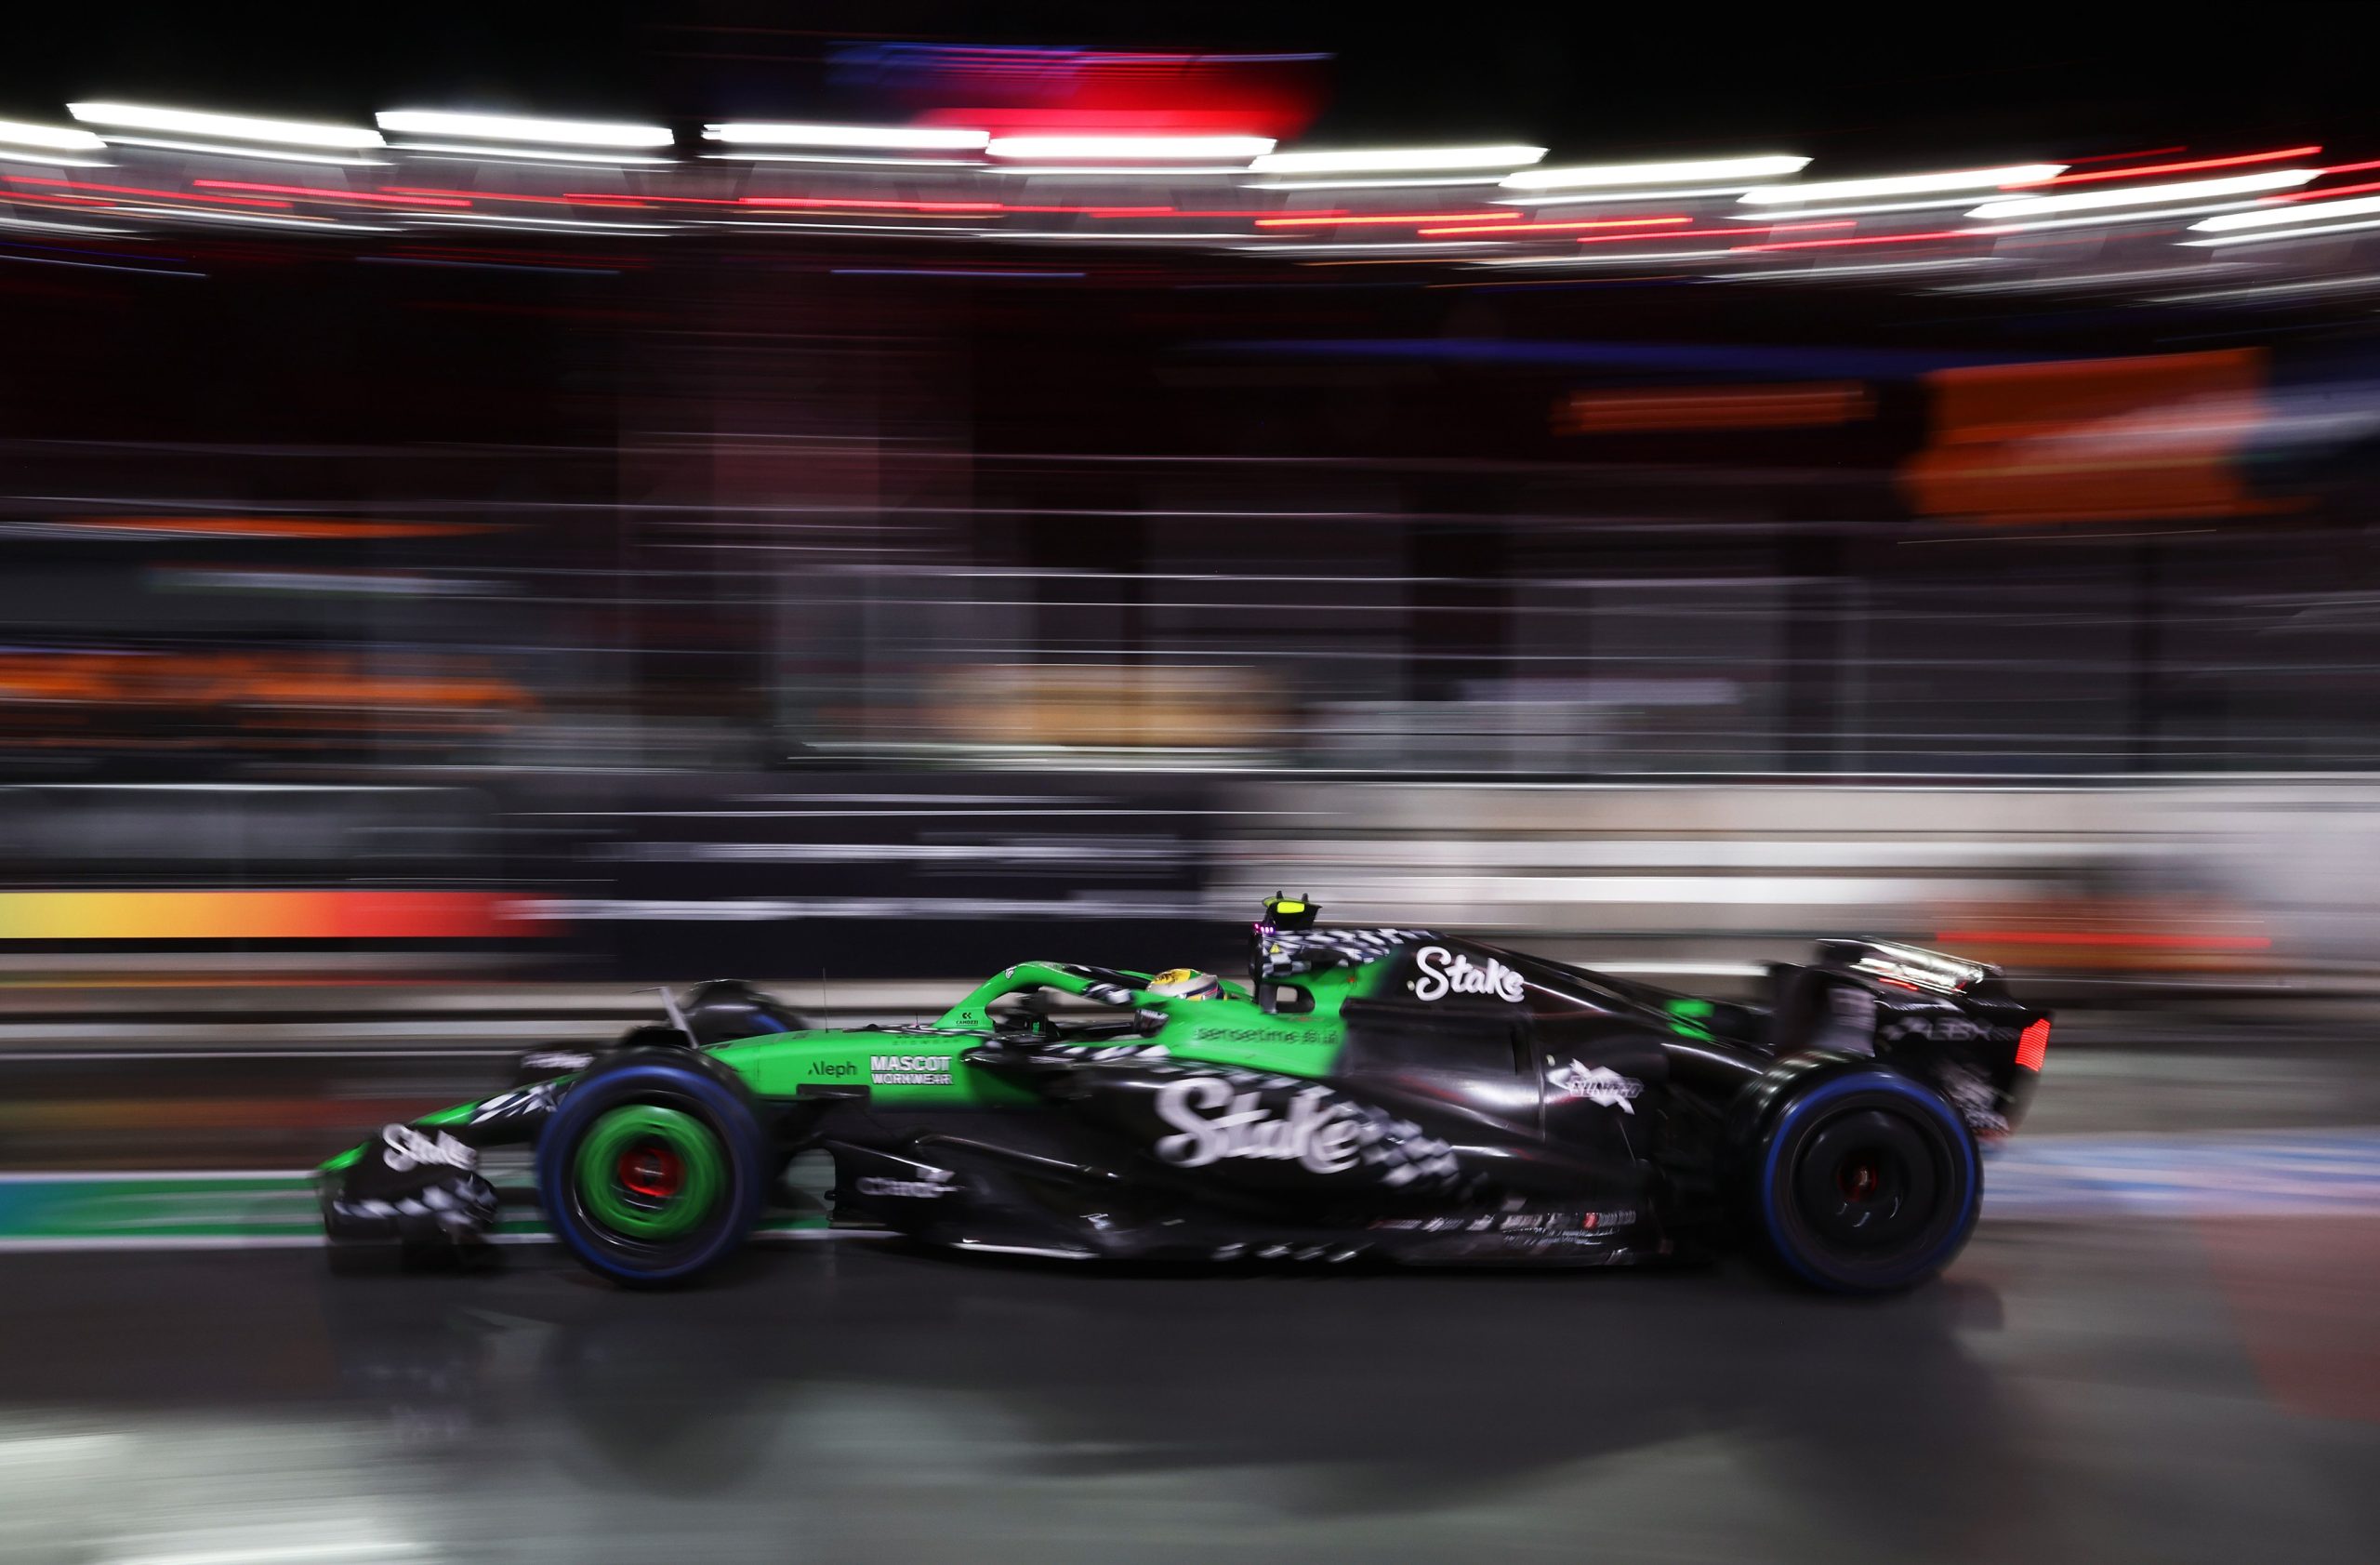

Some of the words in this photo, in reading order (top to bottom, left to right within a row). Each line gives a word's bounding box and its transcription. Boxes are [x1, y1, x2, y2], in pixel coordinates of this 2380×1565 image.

[1415, 946, 1525, 1002] Stake
[808, 1061, 857, 1078] Aleph
[870, 1055, 952, 1071] MASCOT
[871, 1073, 953, 1085] WORKWEAR
[1154, 1077, 1362, 1174] Stake
